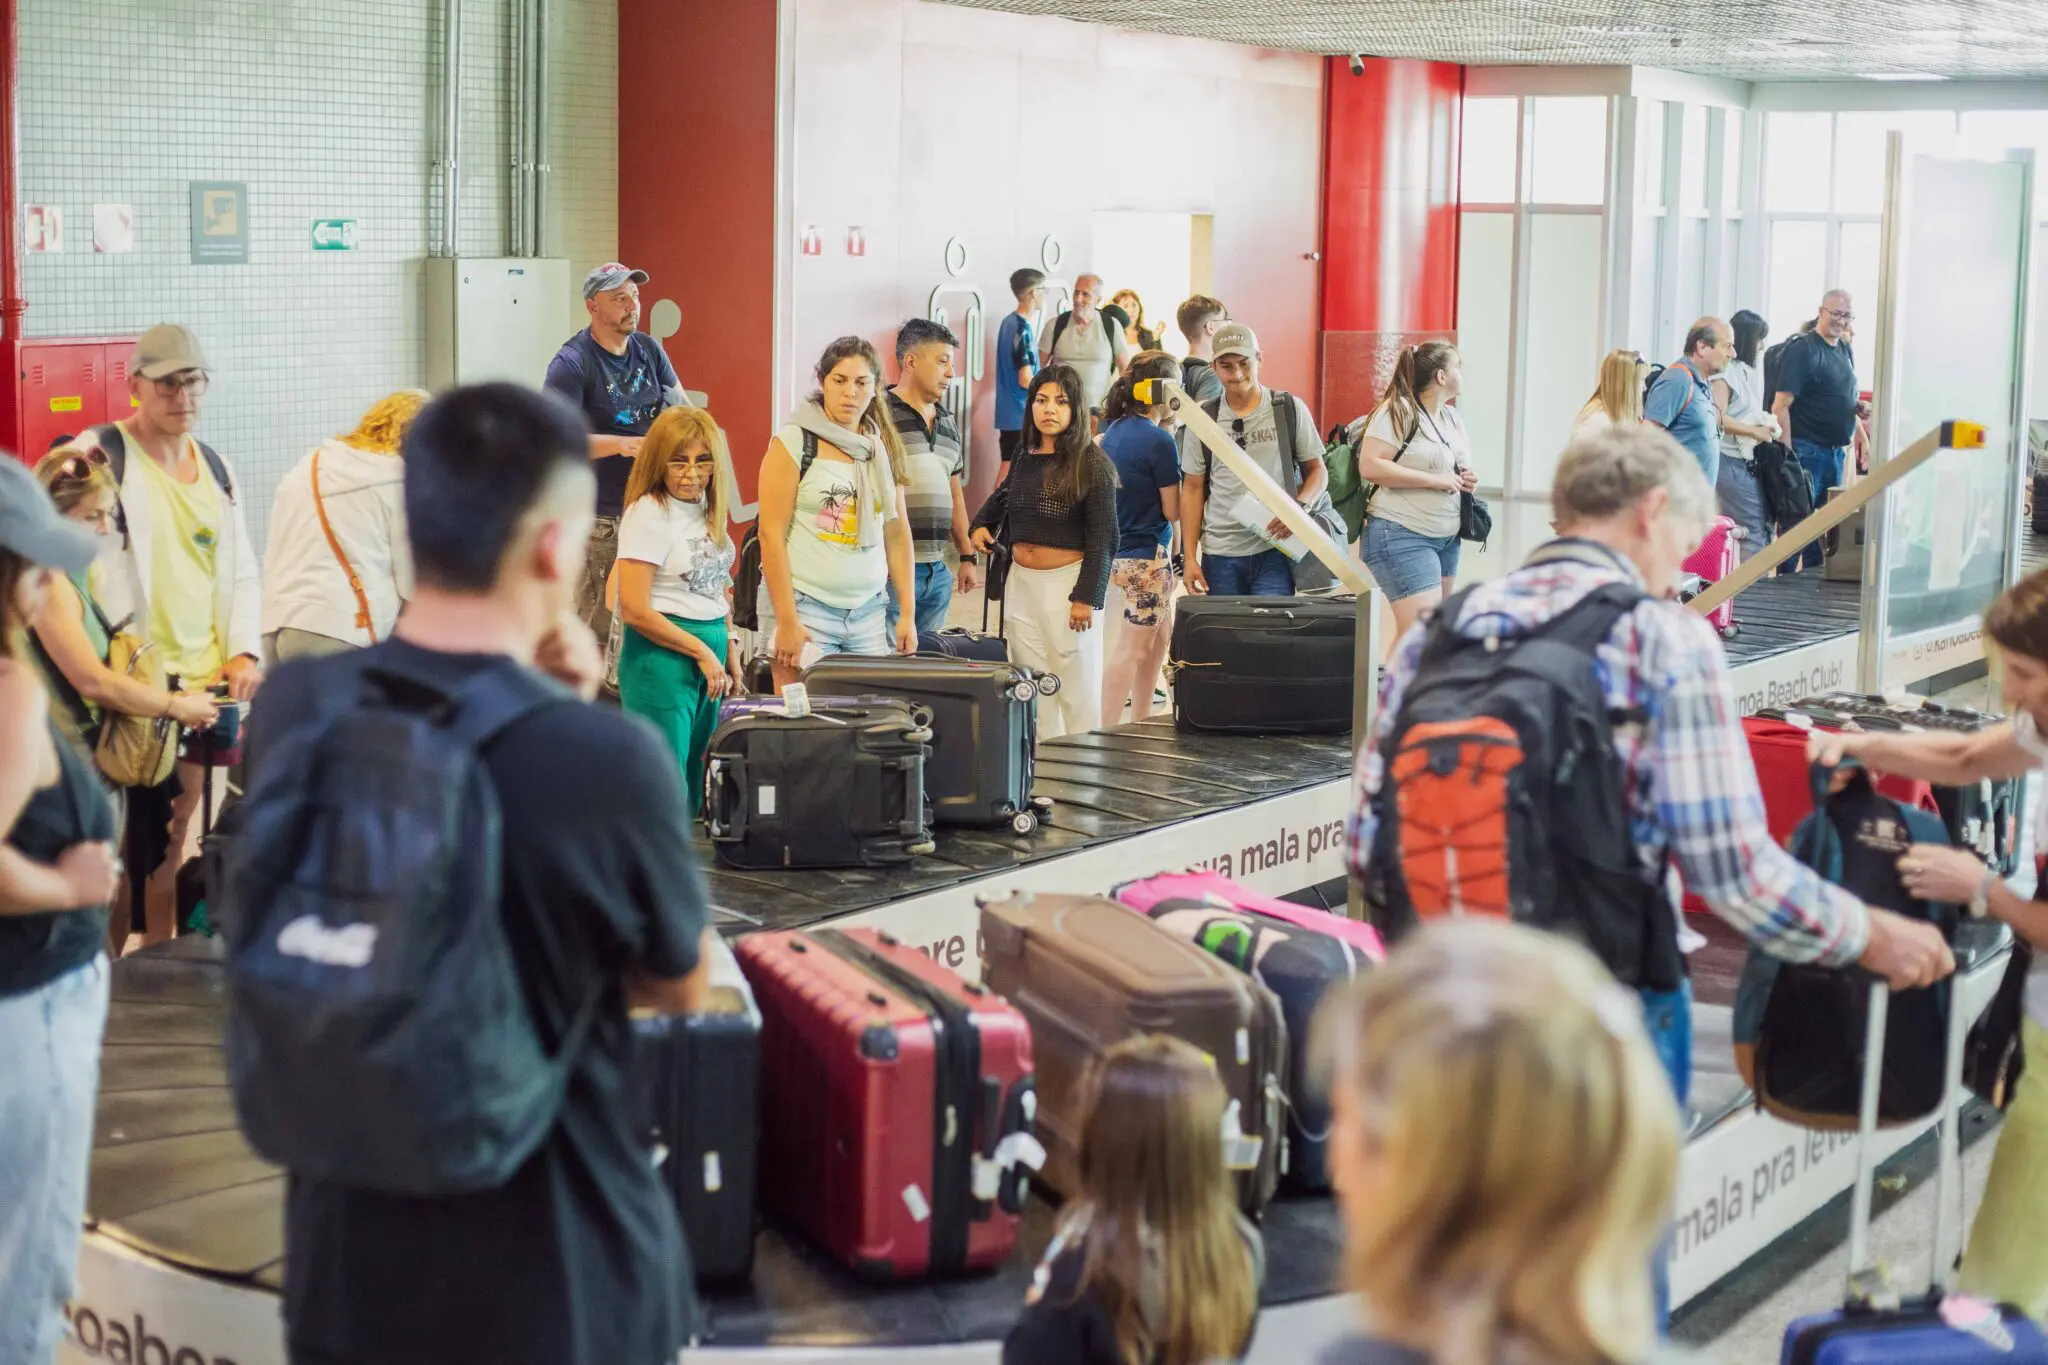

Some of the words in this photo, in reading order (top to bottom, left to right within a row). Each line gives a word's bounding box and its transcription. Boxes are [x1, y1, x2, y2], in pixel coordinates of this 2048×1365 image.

[1734, 690, 1764, 716] noa
[1767, 670, 1808, 706] Beach
[1811, 660, 1843, 693] Club!
[1240, 827, 1300, 877] mala
[1307, 819, 1345, 864] pra
[1673, 1176, 1743, 1263] mala
[1751, 1145, 1796, 1220] pra
